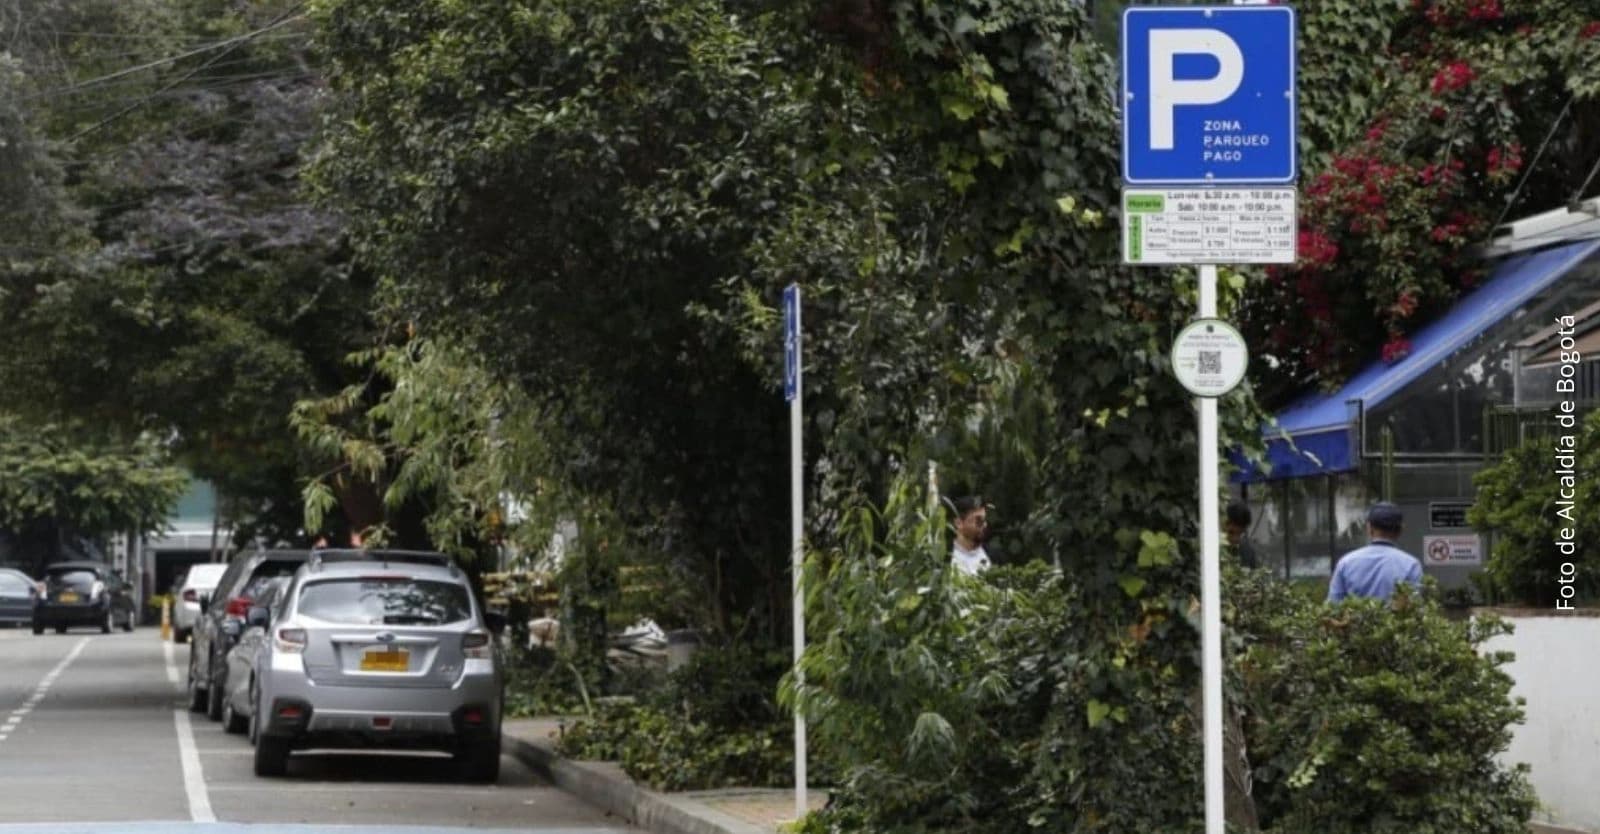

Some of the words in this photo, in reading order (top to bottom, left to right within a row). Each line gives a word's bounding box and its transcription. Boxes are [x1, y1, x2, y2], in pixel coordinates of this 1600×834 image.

[1149, 28, 1245, 150] P
[1203, 120, 1241, 131] ZONA
[1203, 135, 1270, 146] PARQUEO
[1203, 151, 1242, 161] PAGO
